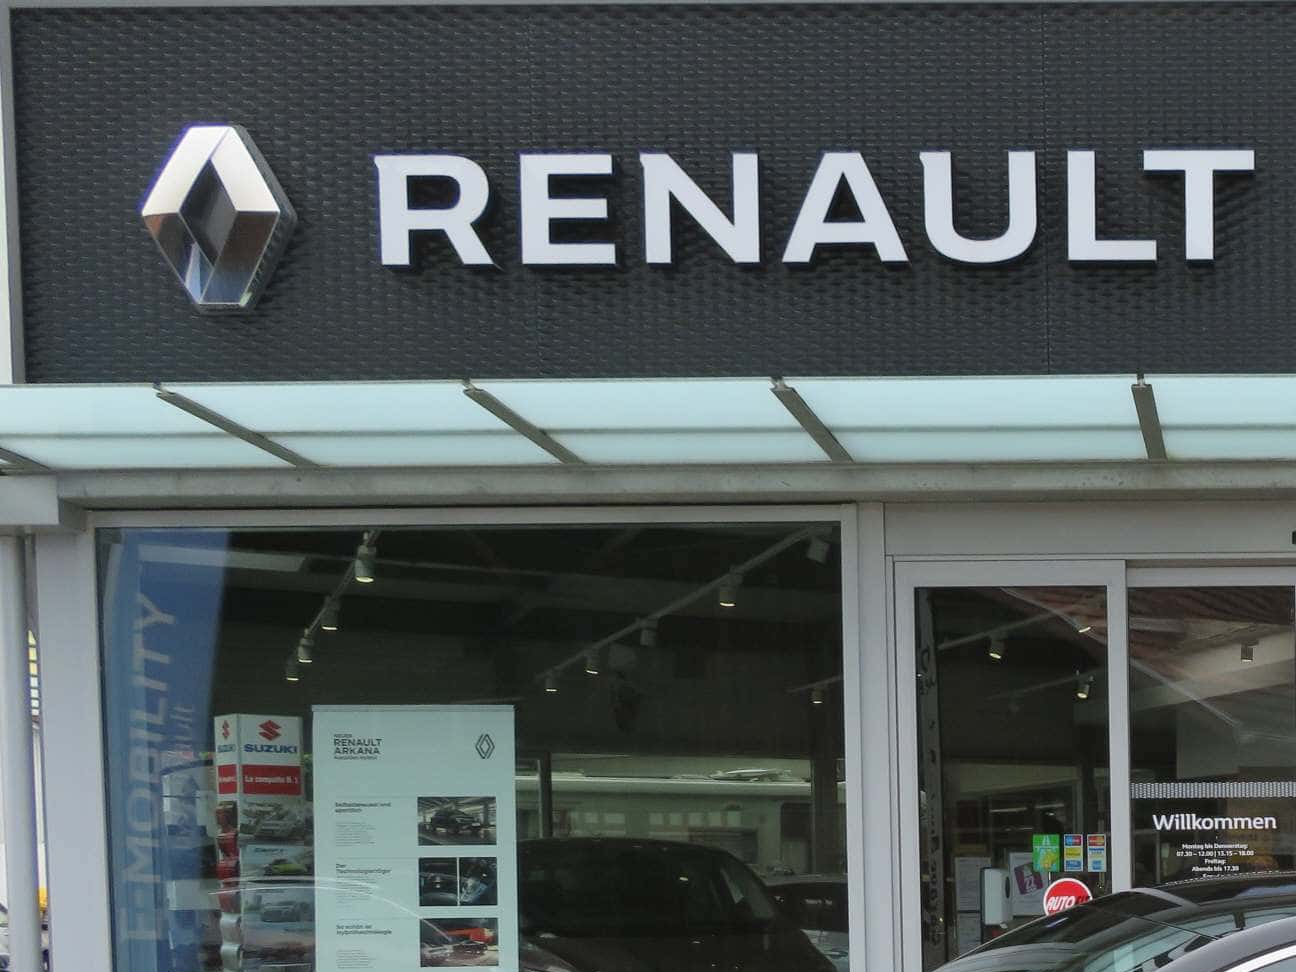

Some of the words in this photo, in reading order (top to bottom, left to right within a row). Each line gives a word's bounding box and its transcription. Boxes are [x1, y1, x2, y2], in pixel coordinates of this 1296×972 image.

[374, 149, 1255, 265] RENAULT
[333, 738, 383, 747] RENAULT
[243, 743, 298, 753] SUZUKI
[334, 747, 381, 755] ARKANA
[1152, 813, 1277, 831] Willkommen
